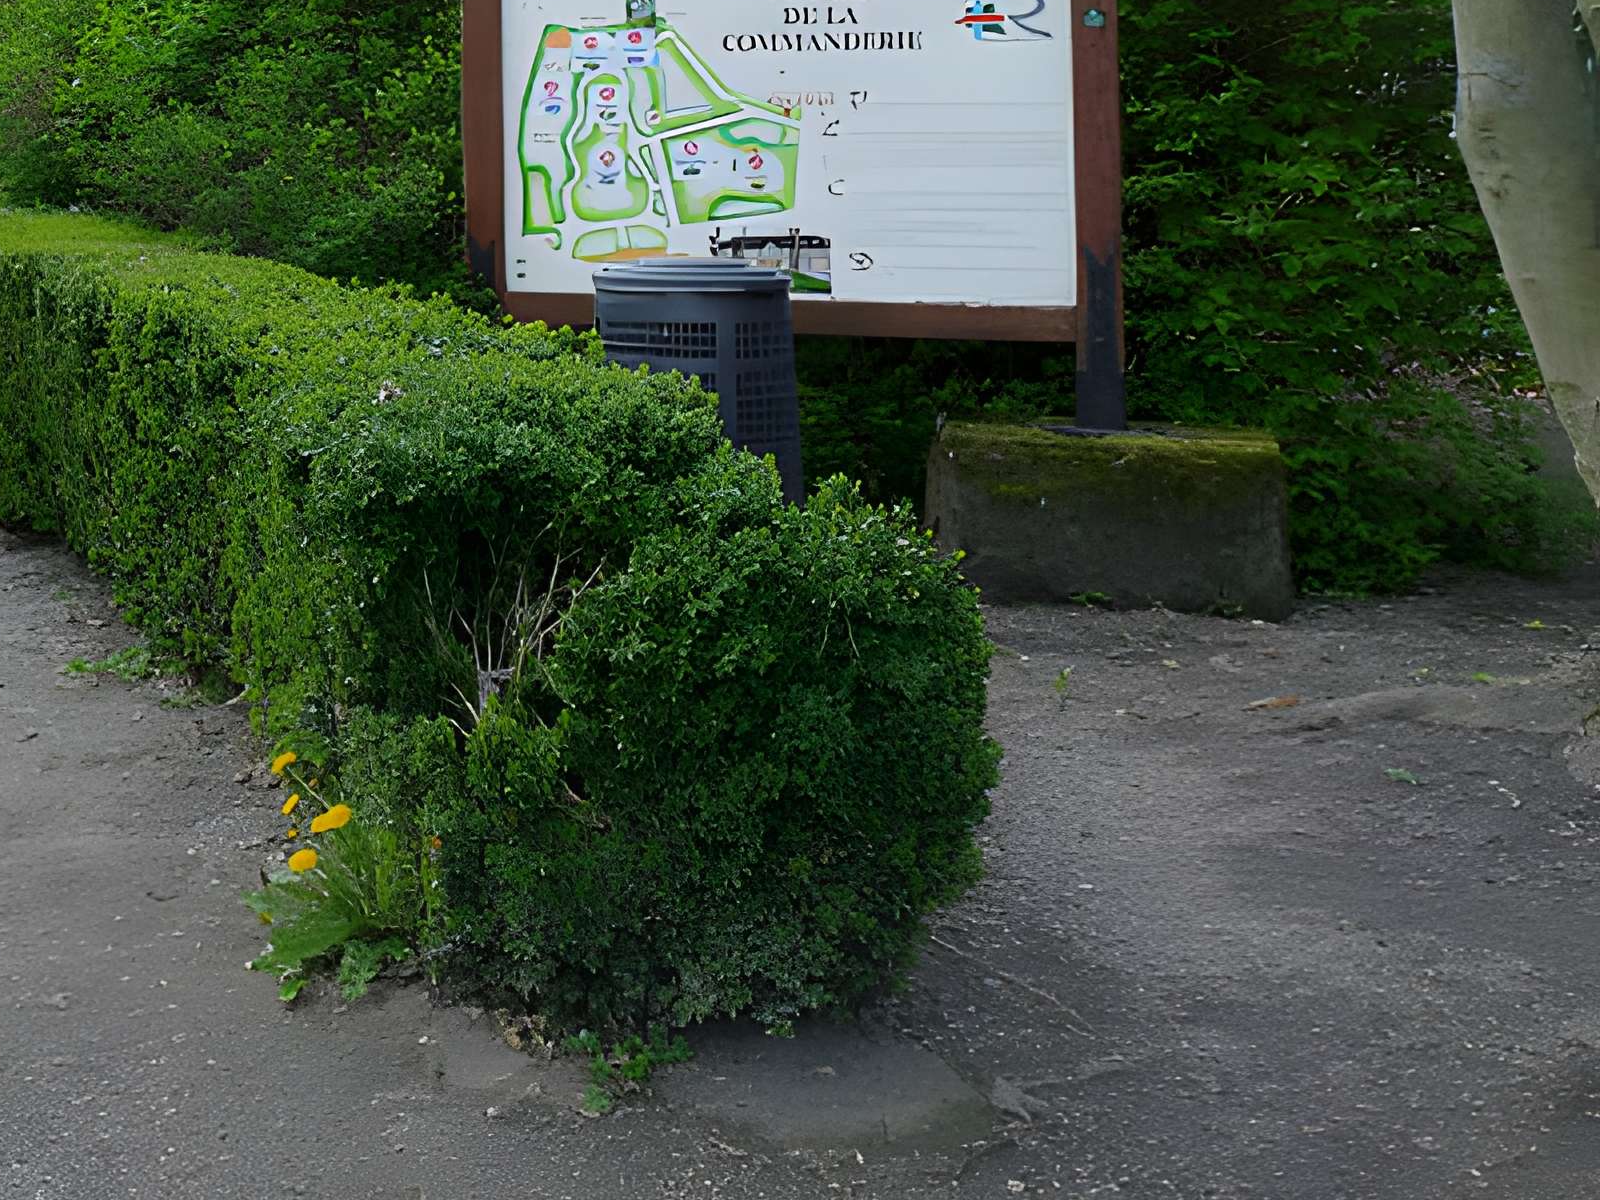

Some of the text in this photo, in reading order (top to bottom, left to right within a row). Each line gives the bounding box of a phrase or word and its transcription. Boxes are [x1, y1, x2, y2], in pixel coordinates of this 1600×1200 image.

[784, 6, 859, 25] DE LA
[722, 31, 923, 52] COMMANDERIE
